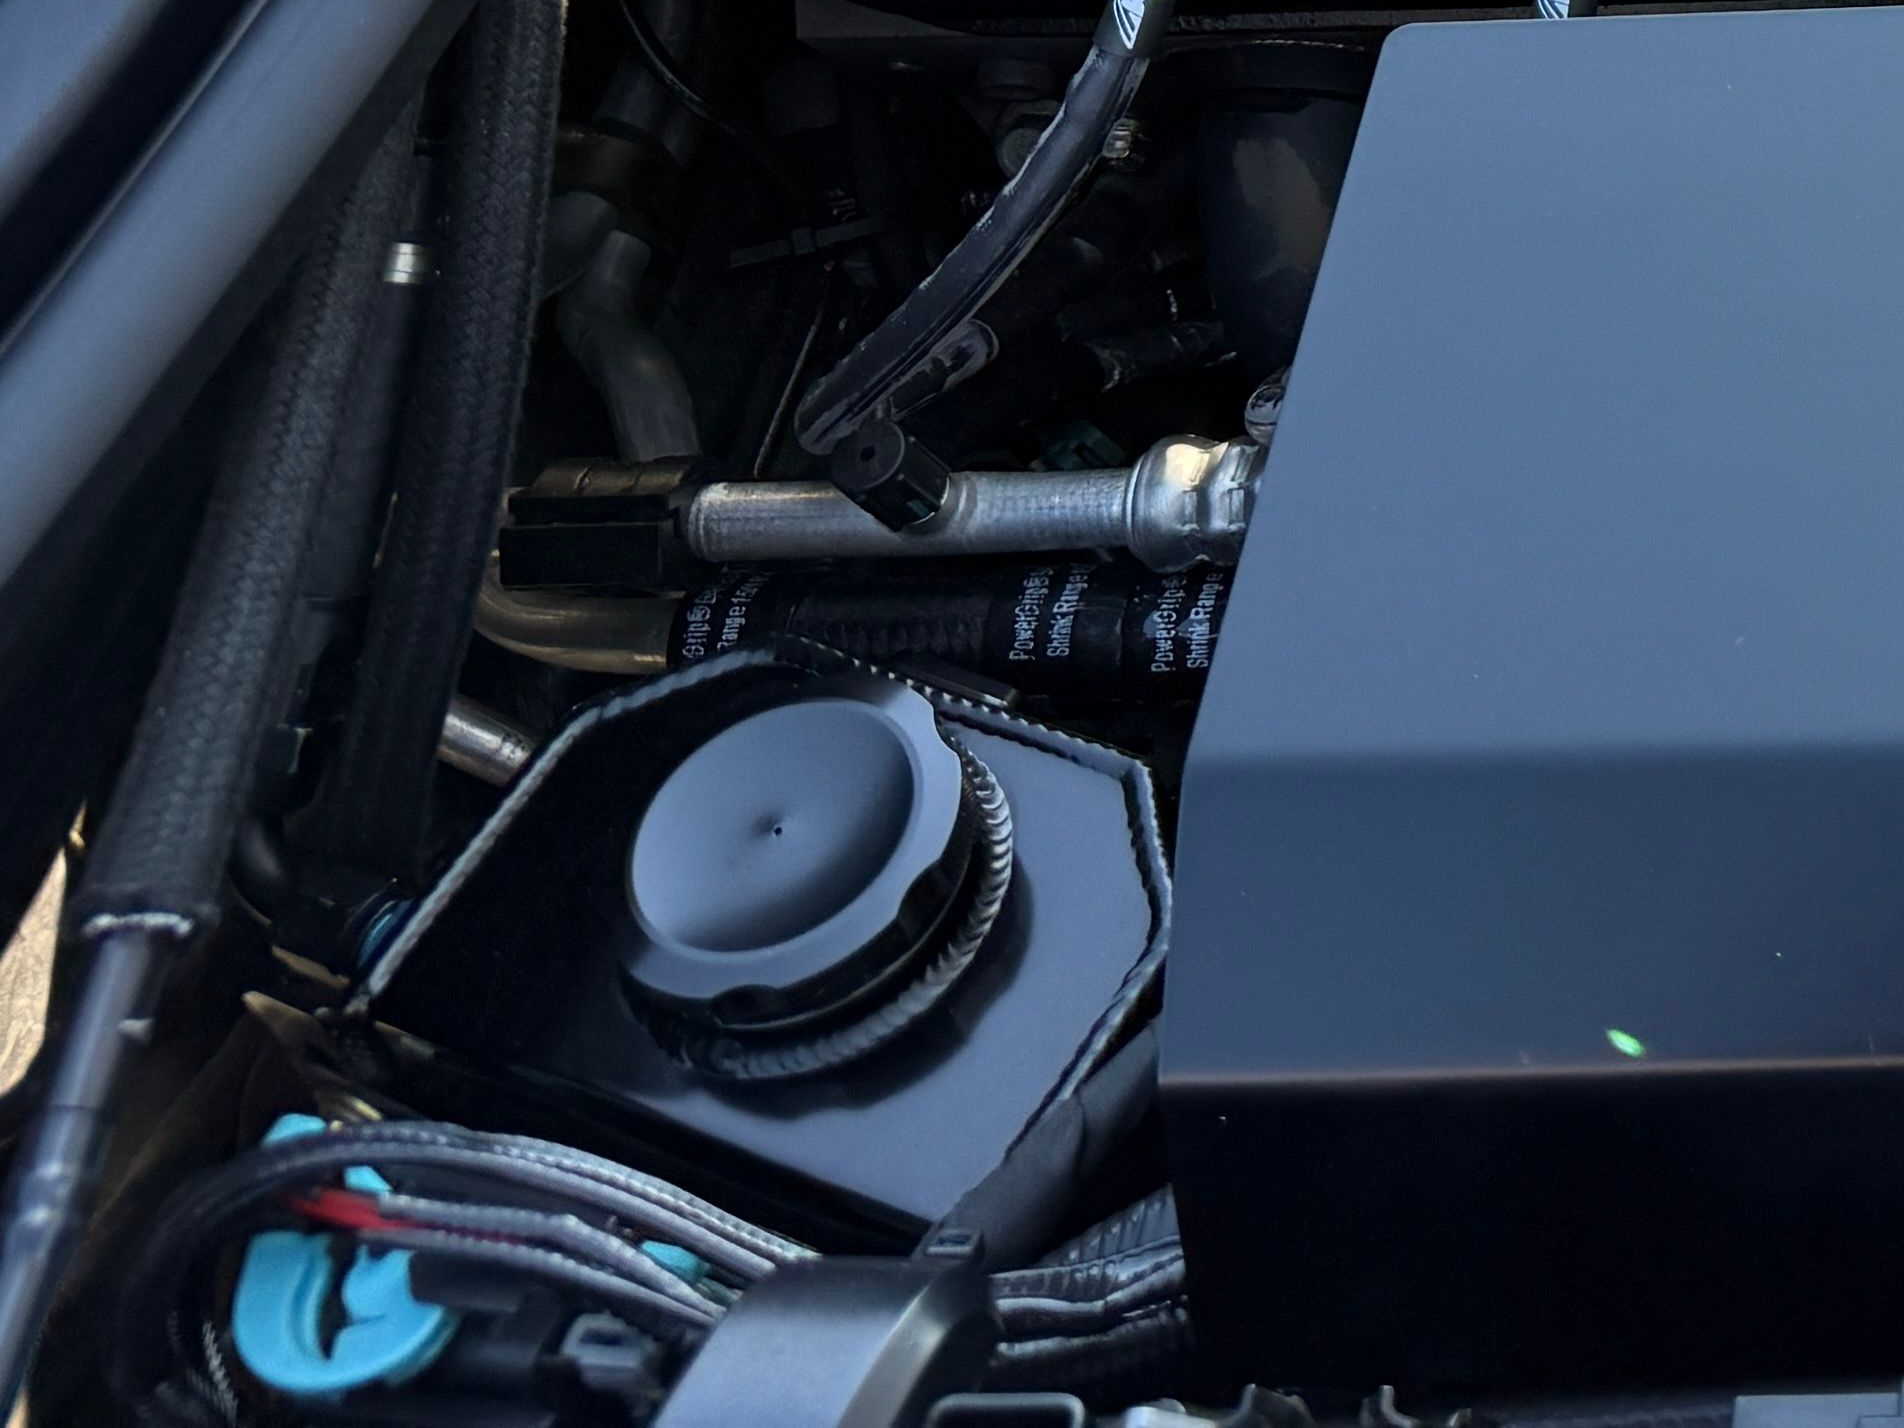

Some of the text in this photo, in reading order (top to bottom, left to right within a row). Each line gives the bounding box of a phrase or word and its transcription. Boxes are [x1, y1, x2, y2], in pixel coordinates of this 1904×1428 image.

[1046, 614, 1075, 658] Shrink
[1186, 572, 1225, 670] Shrink Range
